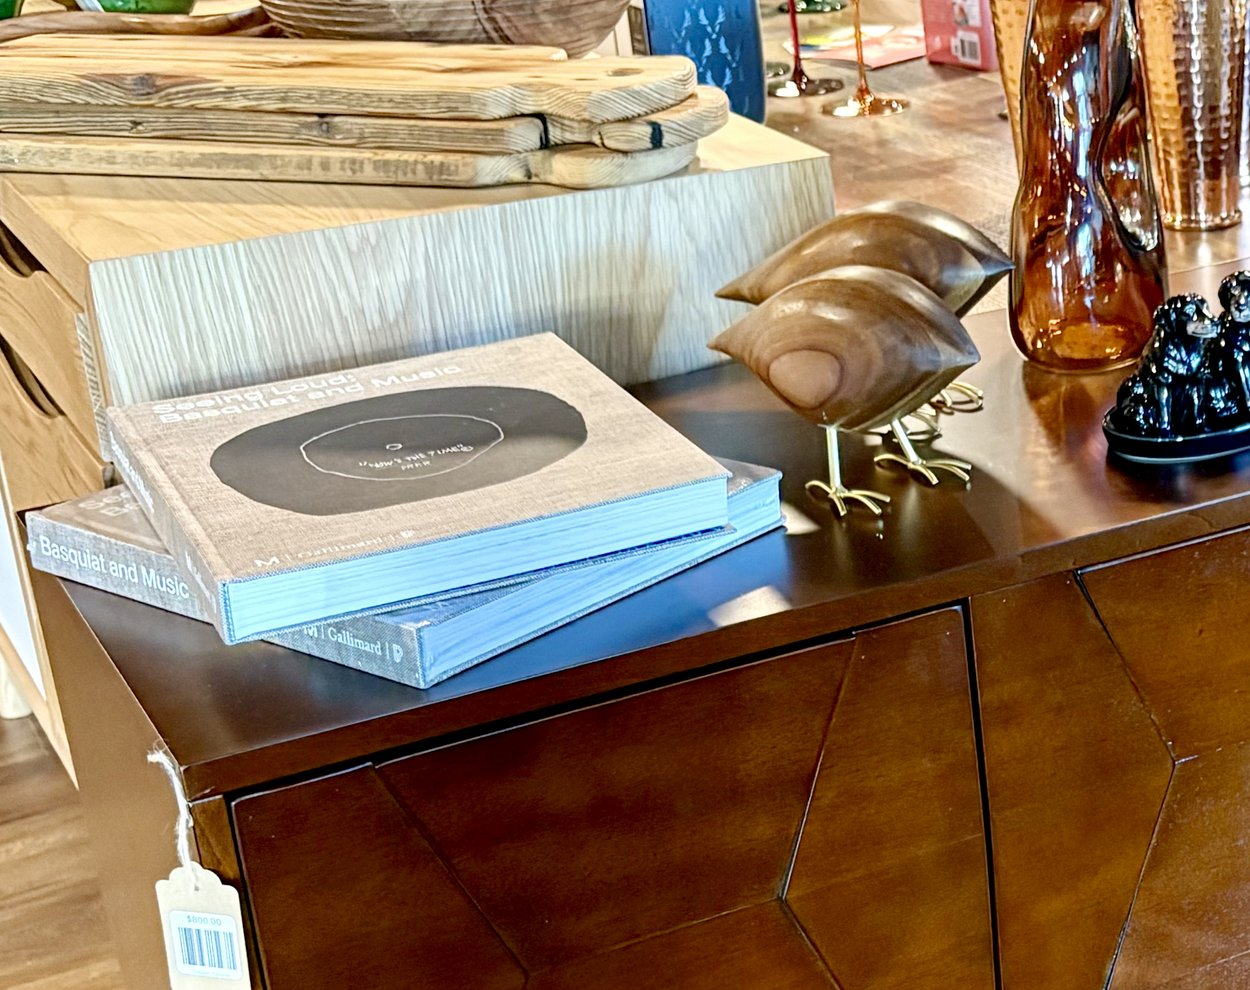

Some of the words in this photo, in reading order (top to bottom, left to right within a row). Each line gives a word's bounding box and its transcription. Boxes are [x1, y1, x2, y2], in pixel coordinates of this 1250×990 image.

[151, 388, 264, 416] Seeing
[271, 374, 357, 397] Loud:
[159, 391, 301, 425] Basquiat
[308, 381, 364, 401] and
[371, 366, 462, 389] Music
[39, 534, 107, 573] Basquiat
[109, 559, 139, 584] and
[140, 564, 191, 599] Music
[327, 626, 382, 656] Gallimard
